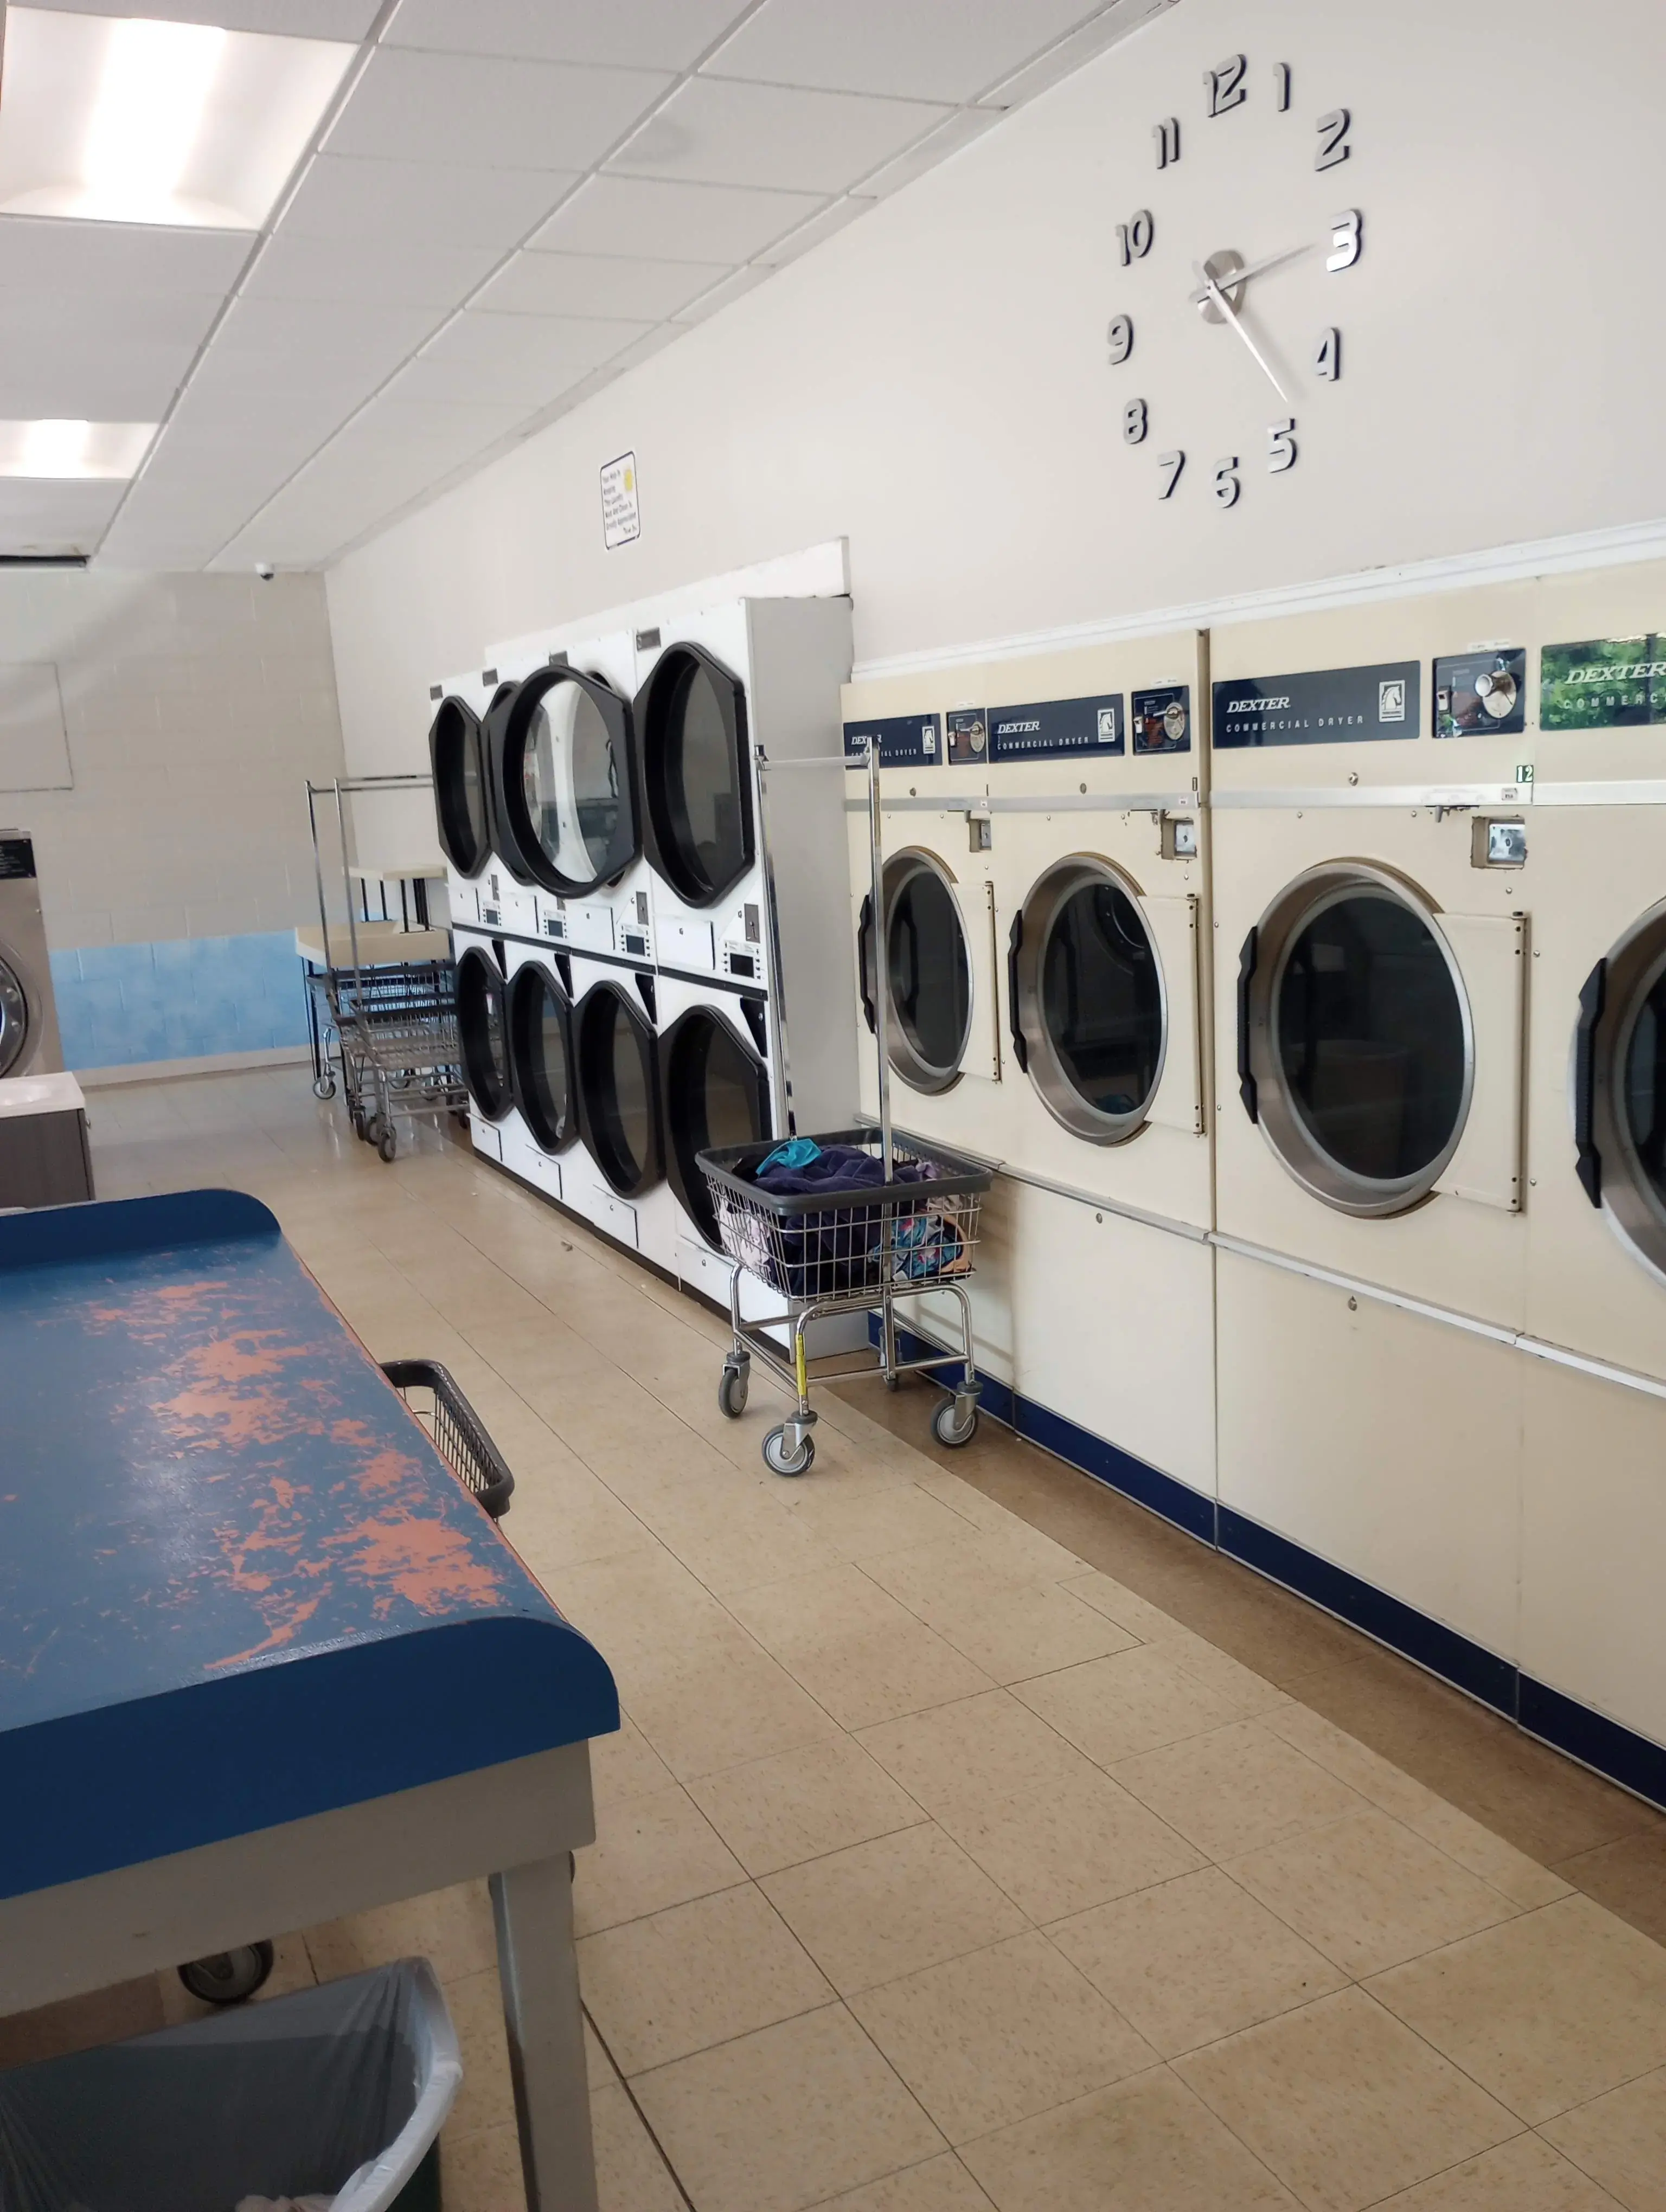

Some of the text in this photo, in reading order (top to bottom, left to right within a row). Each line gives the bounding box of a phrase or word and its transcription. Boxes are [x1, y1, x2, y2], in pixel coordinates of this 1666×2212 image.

[1203, 54, 1246, 117] 12
[1273, 62, 1291, 112] 1
[1152, 117, 1180, 170] 11
[1315, 107, 1350, 171] 2
[1116, 209, 1154, 266] 10
[1326, 208, 1362, 272] 3
[1108, 314, 1133, 364] 9
[1315, 326, 1341, 381] 4
[1123, 398, 1148, 444] 8
[1267, 417, 1297, 473] 5
[1158, 449, 1186, 500] 7
[1212, 457, 1240, 509] 6
[1565, 661, 1666, 685] DEXTER
[1226, 697, 1291, 713] DEXTER
[1226, 715, 1364, 733] COMMERCIAL DRYER
[1564, 692, 1666, 709] COMMERC
[851, 734, 883, 745] DEXR
[997, 721, 1041, 734] DEXTER
[997, 736, 1089, 750] COMMERCIAL DRYER
[1517, 766, 1534, 782] 12
